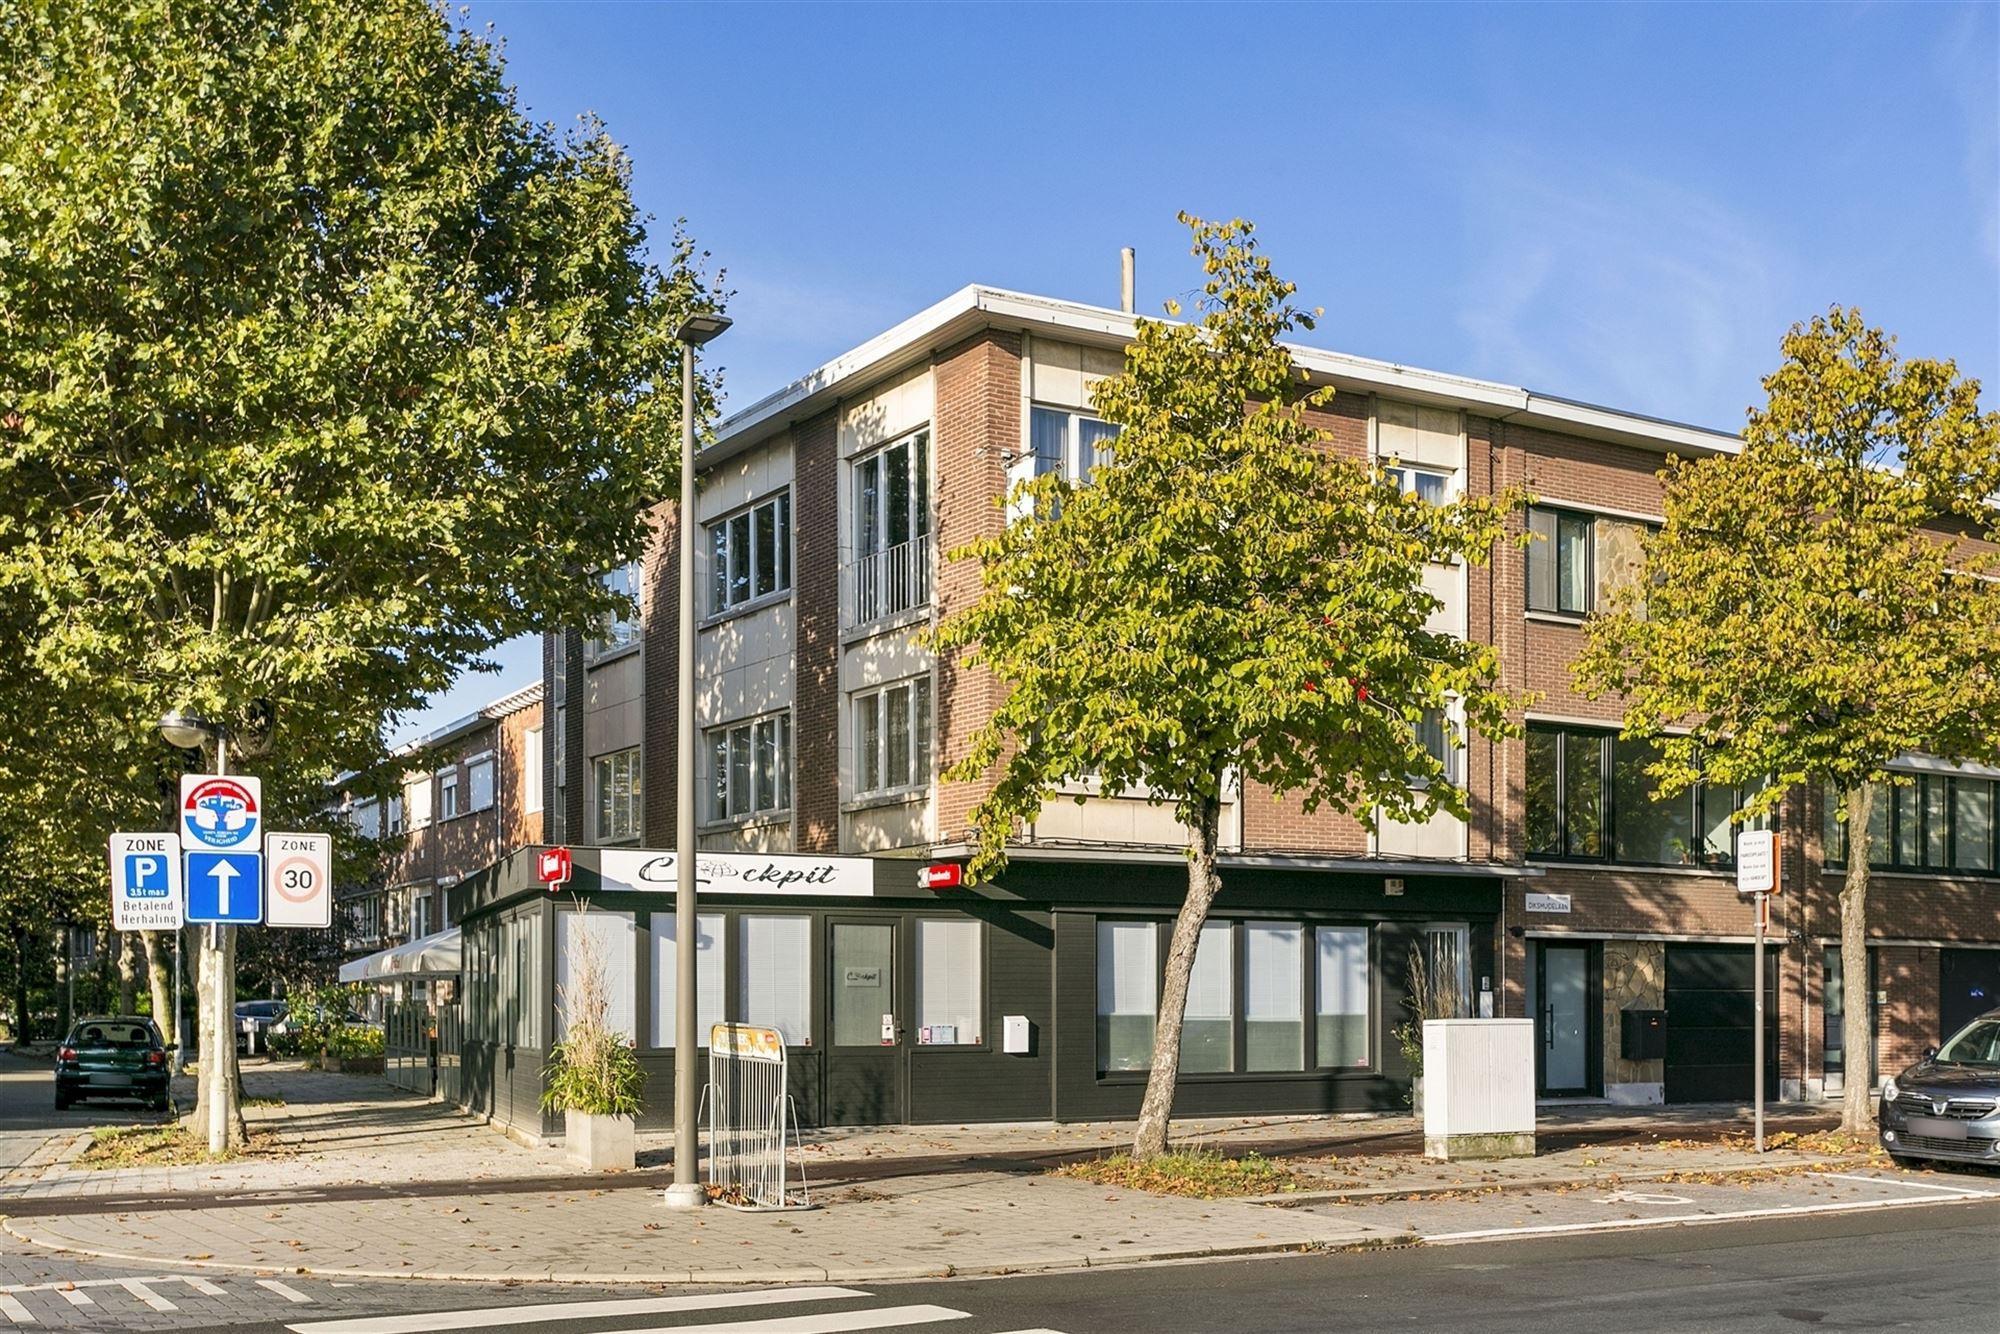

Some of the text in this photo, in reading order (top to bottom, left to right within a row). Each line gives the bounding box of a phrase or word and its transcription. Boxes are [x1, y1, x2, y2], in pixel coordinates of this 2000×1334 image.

[126, 839, 166, 851] ZONE
[281, 840, 317, 851] ZONE
[135, 857, 158, 888] P
[284, 869, 313, 889] 30
[148, 889, 165, 897] max
[123, 901, 174, 912] Betalend
[121, 914, 177, 926] Herhaling
